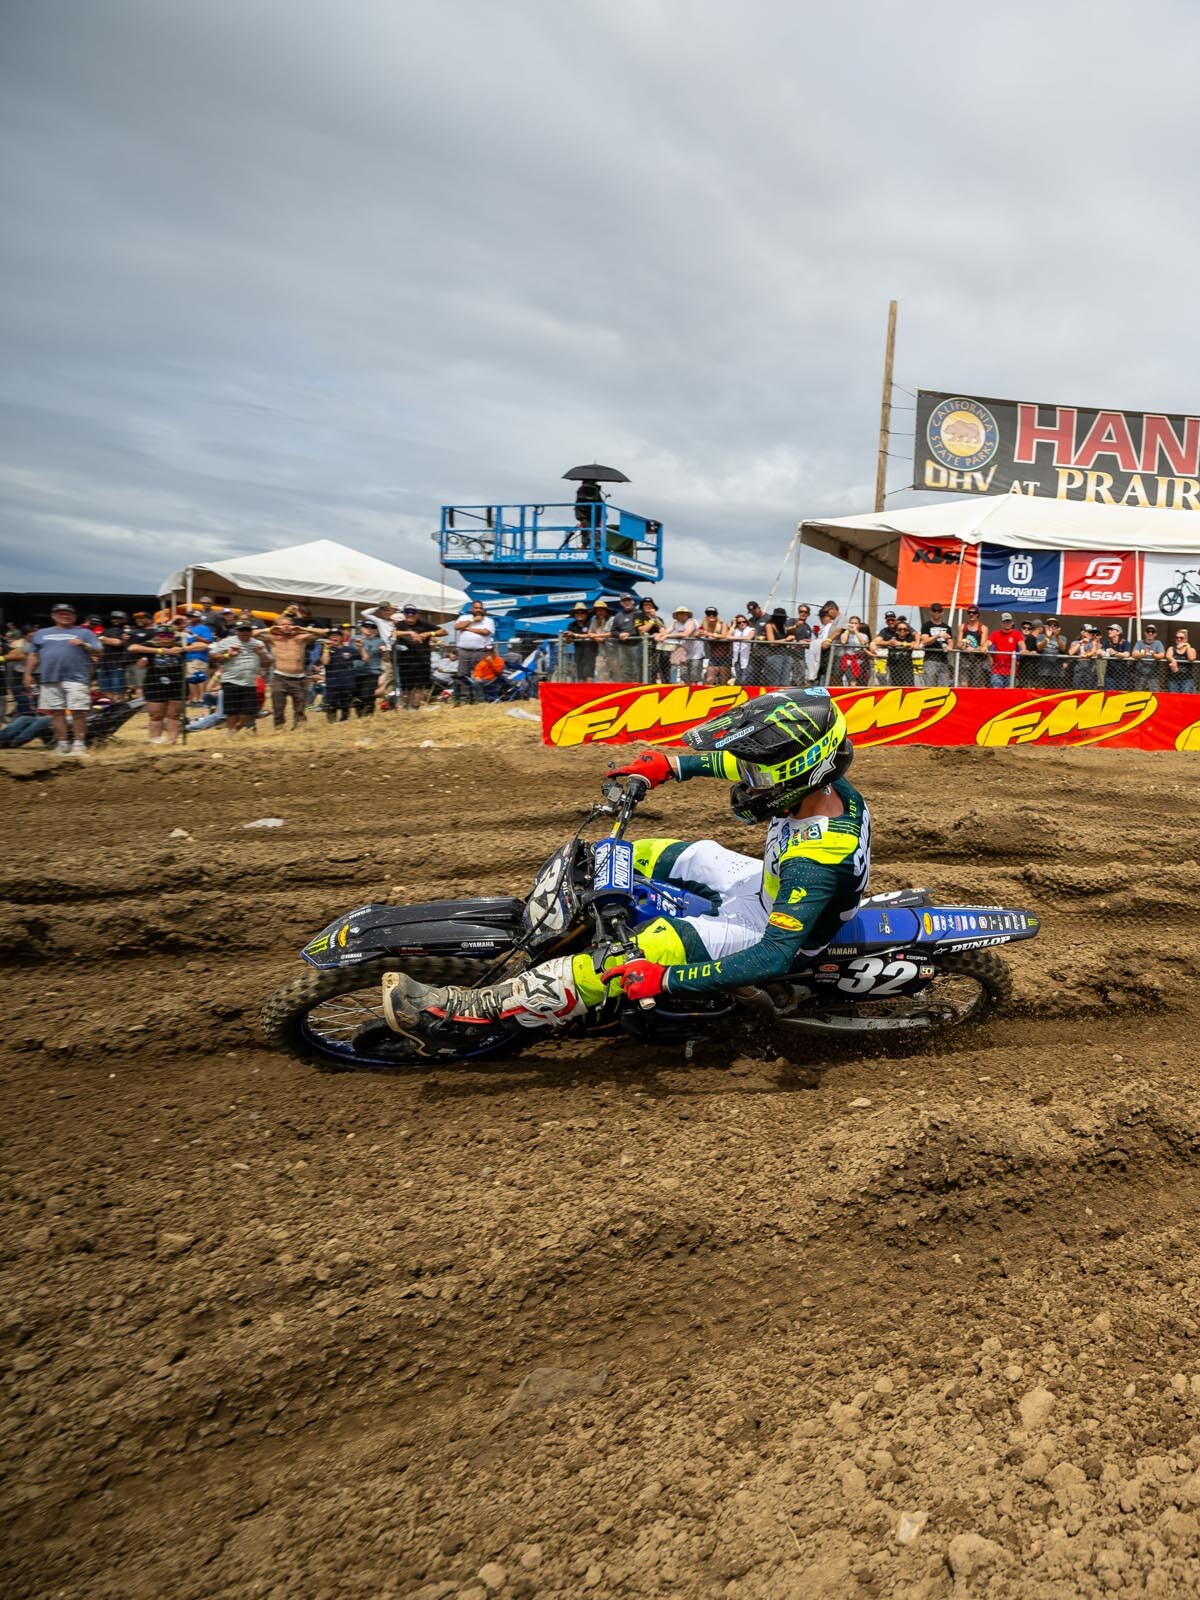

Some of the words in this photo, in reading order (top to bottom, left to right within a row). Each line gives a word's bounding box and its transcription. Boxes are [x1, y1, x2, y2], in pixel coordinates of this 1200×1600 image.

[932, 400, 994, 433] CALIFORNIA
[930, 435, 960, 467] STATE
[965, 440, 994, 467] PARKS
[1008, 480, 1040, 497] AT
[990, 584, 1048, 598] Husqvarna
[1069, 590, 1134, 602] GASGAS
[557, 686, 742, 746] FMF
[844, 688, 951, 736] MF
[983, 691, 1153, 746] FMF
[774, 729, 839, 781] 100%
[613, 845, 630, 889] PROTAPER
[827, 947, 858, 955] YAMAHA
[950, 935, 1011, 953] DUNLOP
[676, 961, 723, 982] THOR
[837, 957, 918, 995] 32
